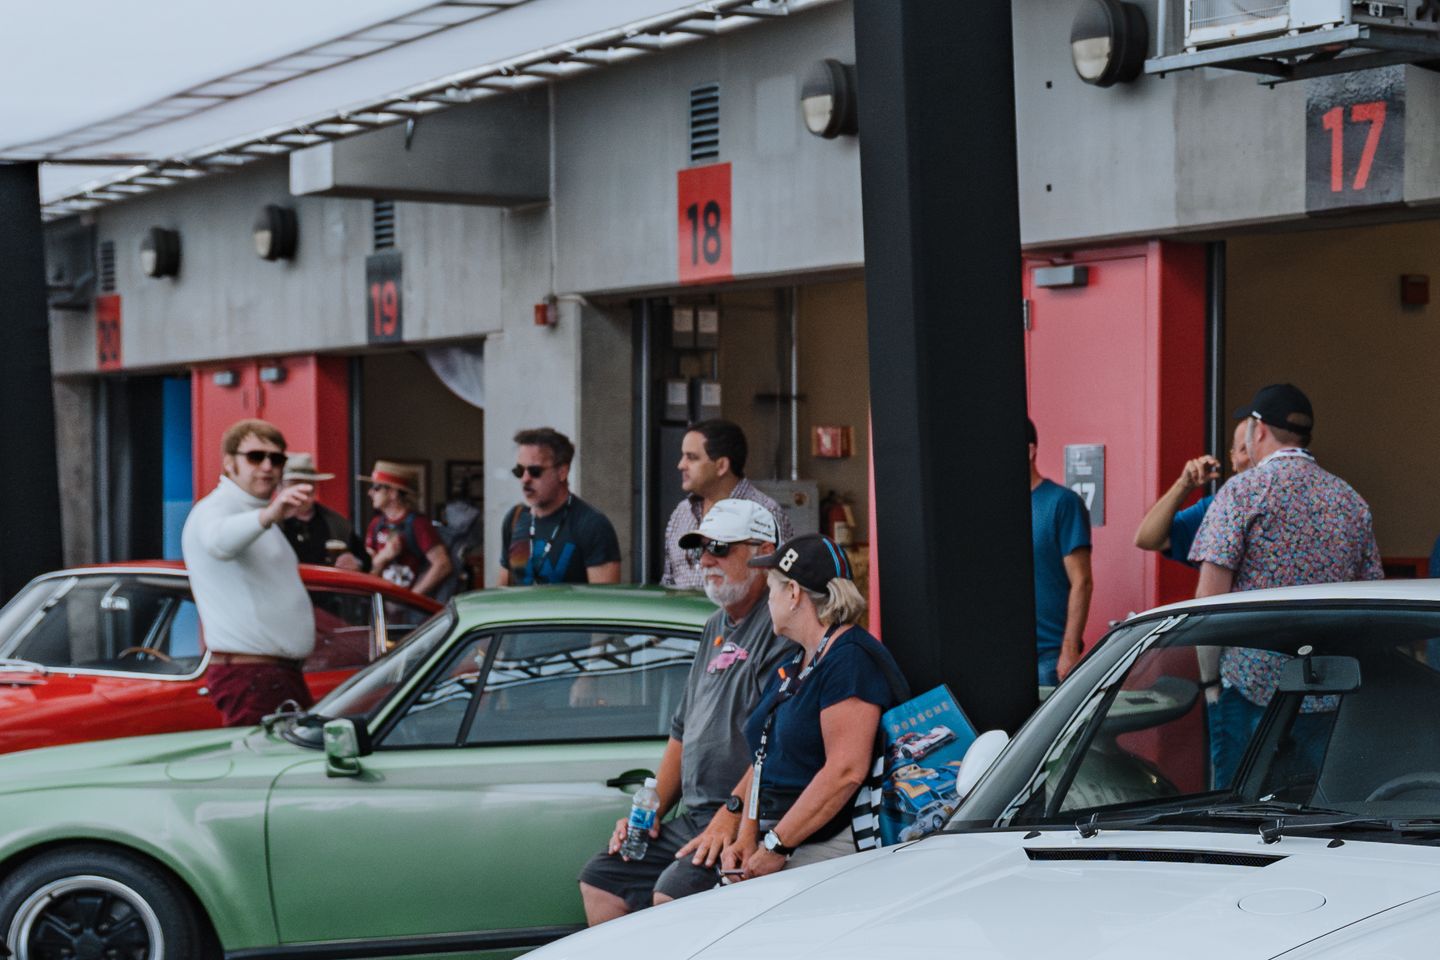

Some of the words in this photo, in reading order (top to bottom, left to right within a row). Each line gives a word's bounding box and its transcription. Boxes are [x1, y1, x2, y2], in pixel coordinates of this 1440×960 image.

[1322, 101, 1387, 192] 17
[687, 200, 722, 266] 18
[370, 280, 399, 337] 19
[778, 548, 799, 572] 8
[892, 701, 950, 733] PORSCHE
